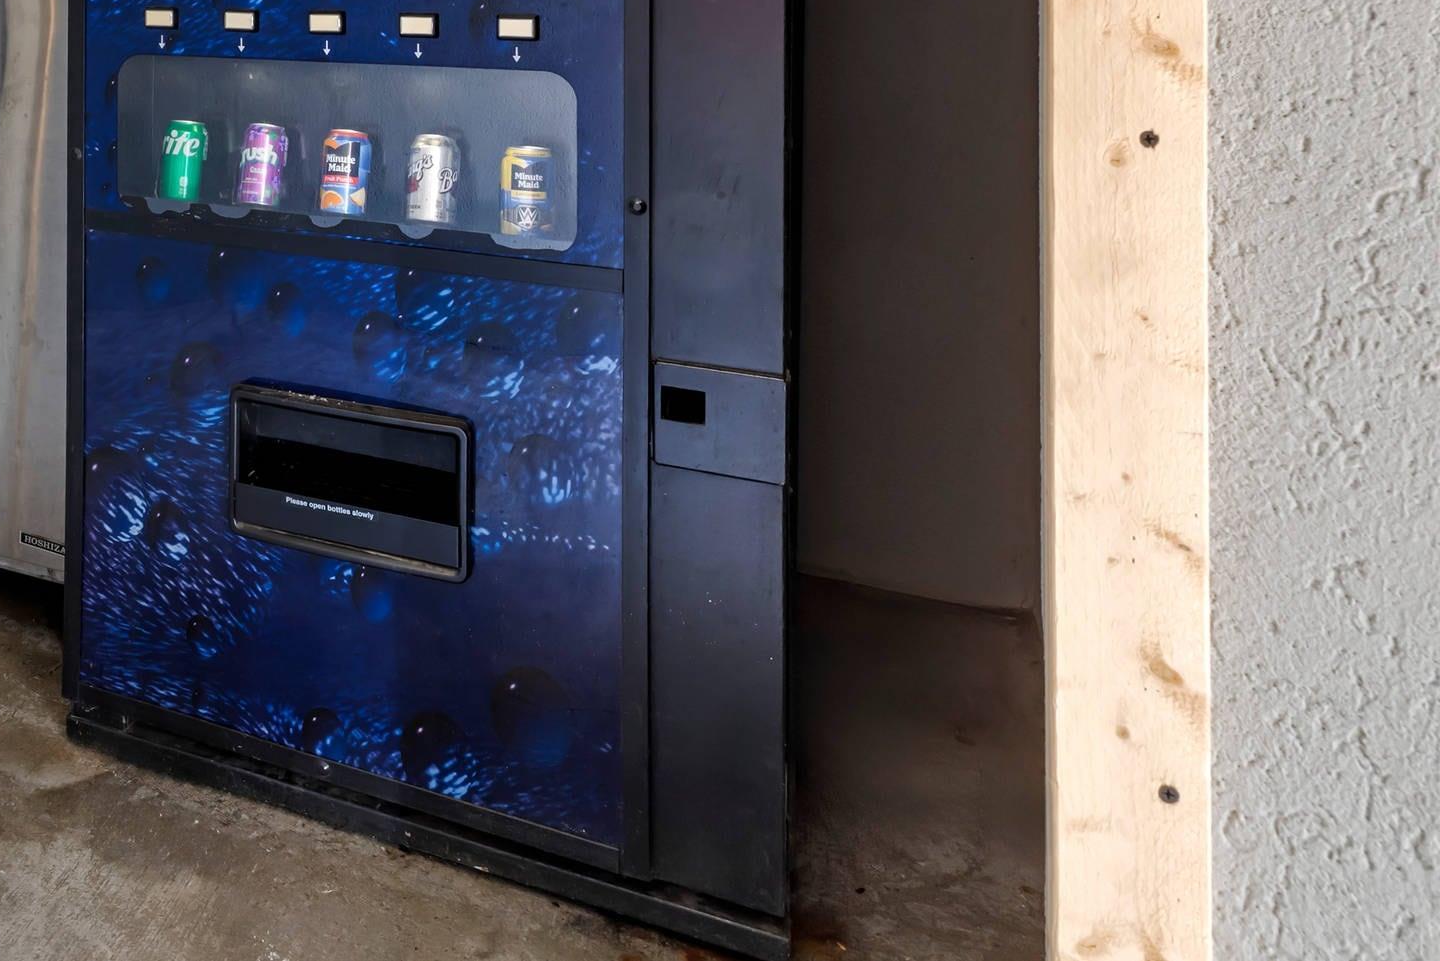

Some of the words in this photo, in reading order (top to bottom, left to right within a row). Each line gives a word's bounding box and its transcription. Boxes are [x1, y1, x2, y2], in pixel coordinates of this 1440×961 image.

[514, 172, 544, 181] Minute
[518, 181, 539, 189] Maid
[285, 496, 308, 507] Please
[327, 505, 351, 515] bottles
[352, 510, 374, 520] slowly
